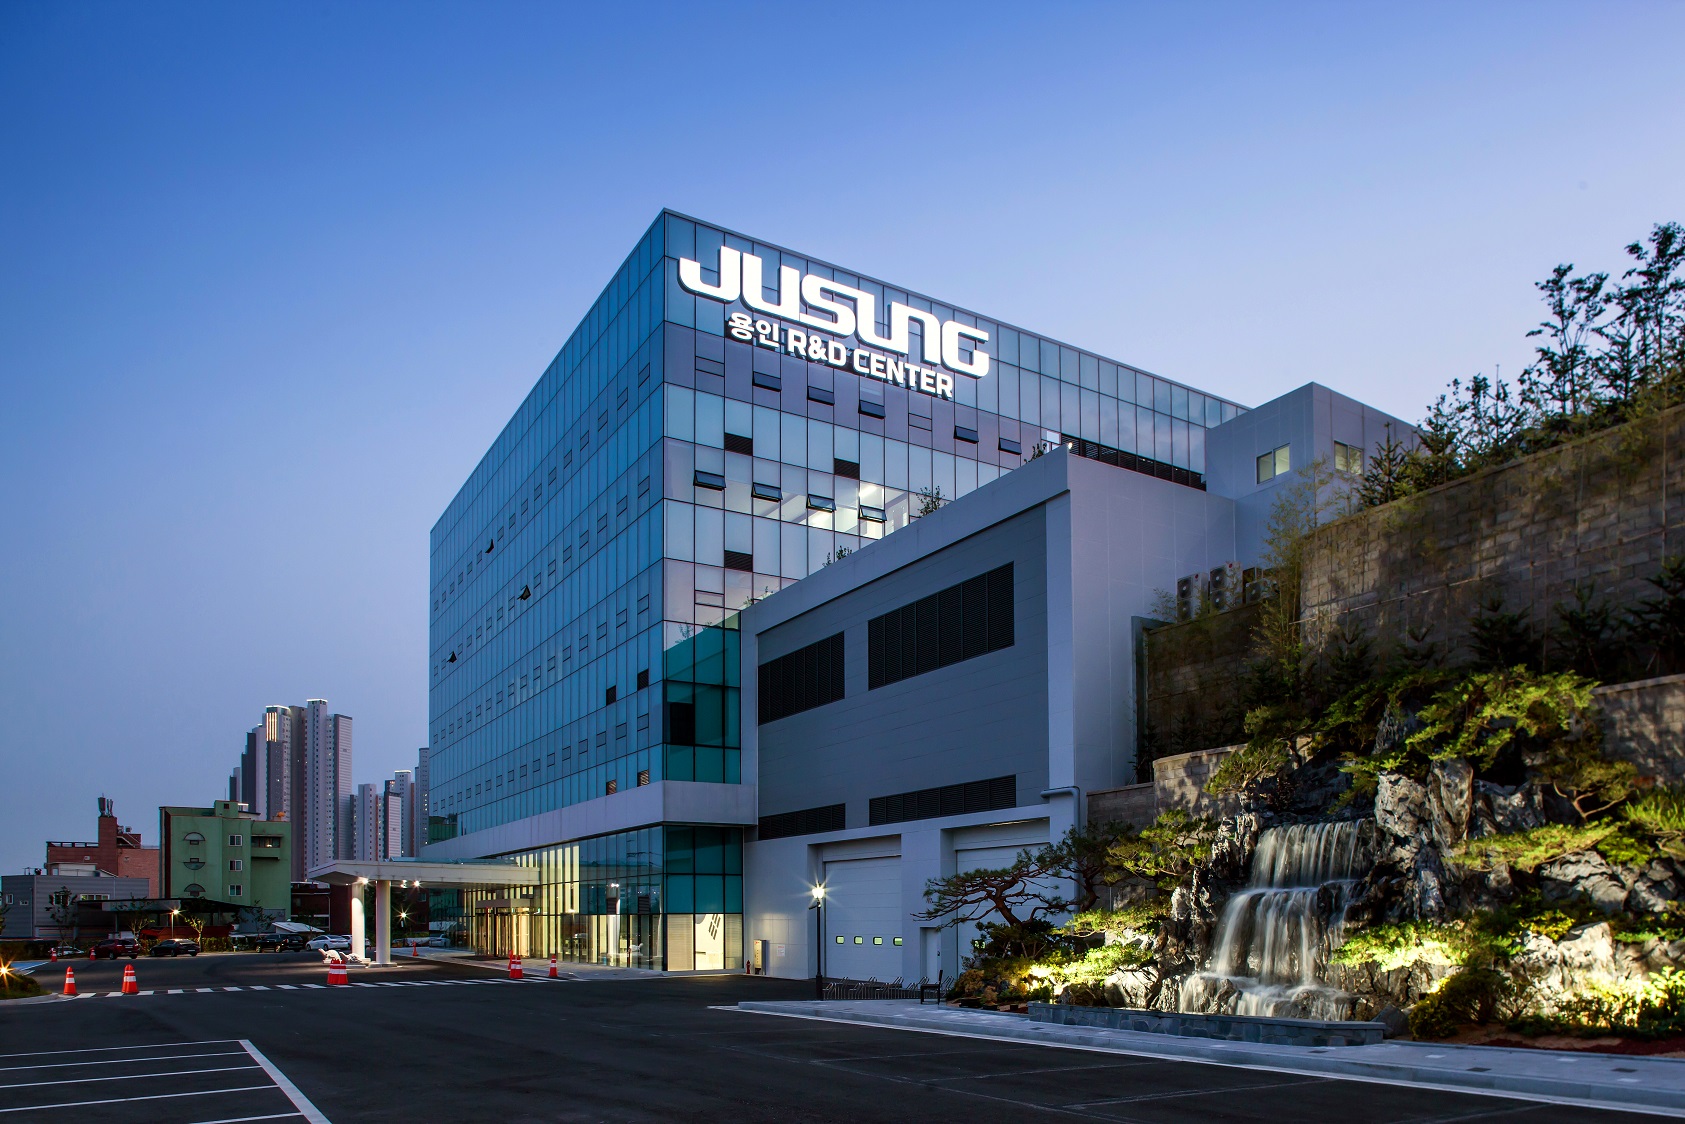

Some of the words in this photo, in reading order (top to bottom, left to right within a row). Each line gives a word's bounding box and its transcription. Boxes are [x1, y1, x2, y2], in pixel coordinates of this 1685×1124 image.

[679, 245, 989, 378] JUSUNG
[728, 312, 780, 348] 용인
[787, 328, 847, 366] R&D
[853, 348, 953, 398] CENTER
